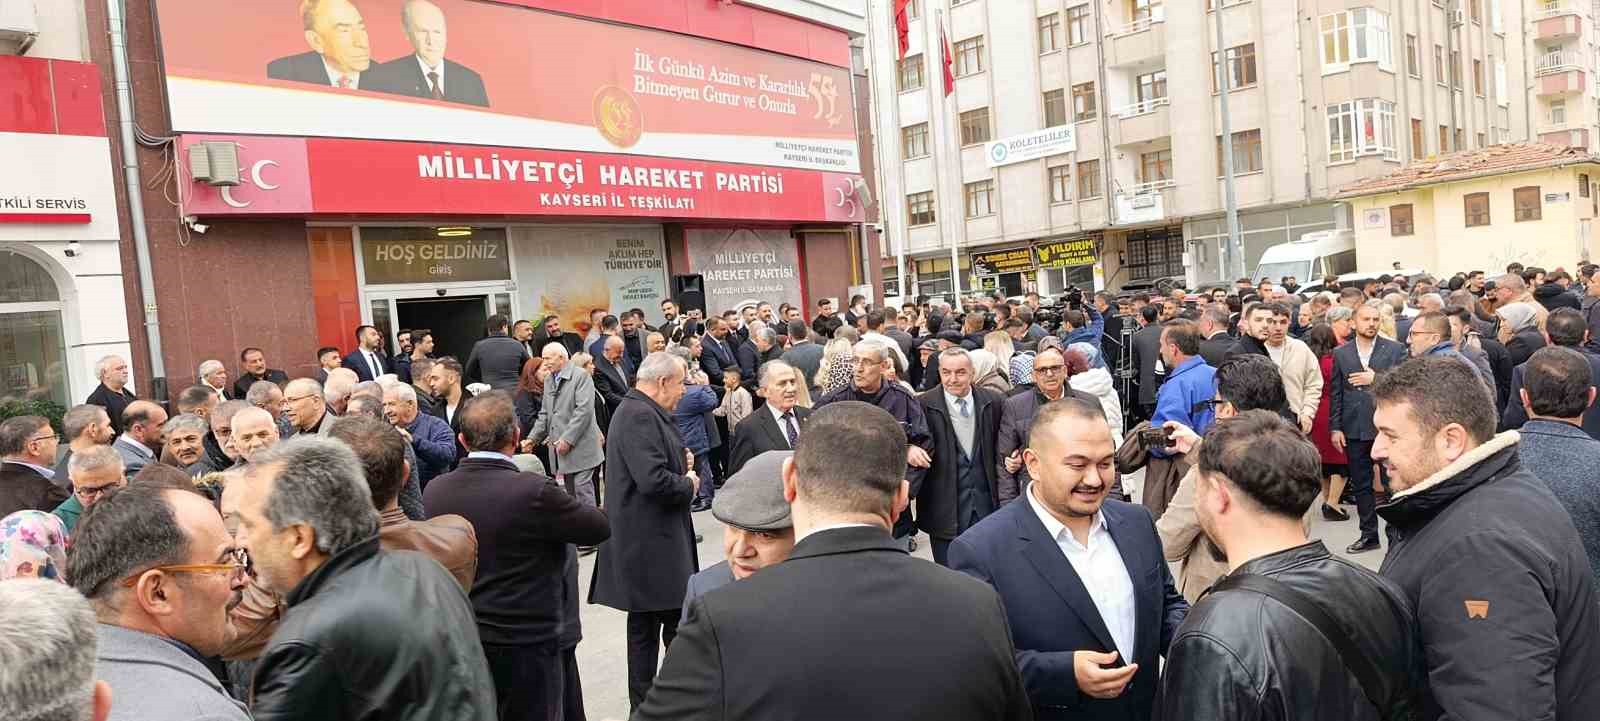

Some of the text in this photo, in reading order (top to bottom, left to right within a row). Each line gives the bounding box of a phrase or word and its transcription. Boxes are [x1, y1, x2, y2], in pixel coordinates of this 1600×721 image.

[634, 48, 655, 73] İlk
[708, 65, 741, 87] Azim
[744, 76, 756, 89] ve
[633, 74, 797, 115] Bitmeyen Gurur ve Onurla
[418, 151, 784, 194] MİLLİYETÇİ HAREKET PARTİSİ
[35, 197, 87, 209] SERVİS
[540, 192, 695, 211] KAYSERİ İL TEŞKİLATI
[375, 240, 498, 264] HOŞ GELDİNİZ
[1050, 240, 1096, 254] YILDIRIM
[715, 250, 776, 265] MİLLİYETÇİ
[754, 264, 793, 279] PARTİSİ
